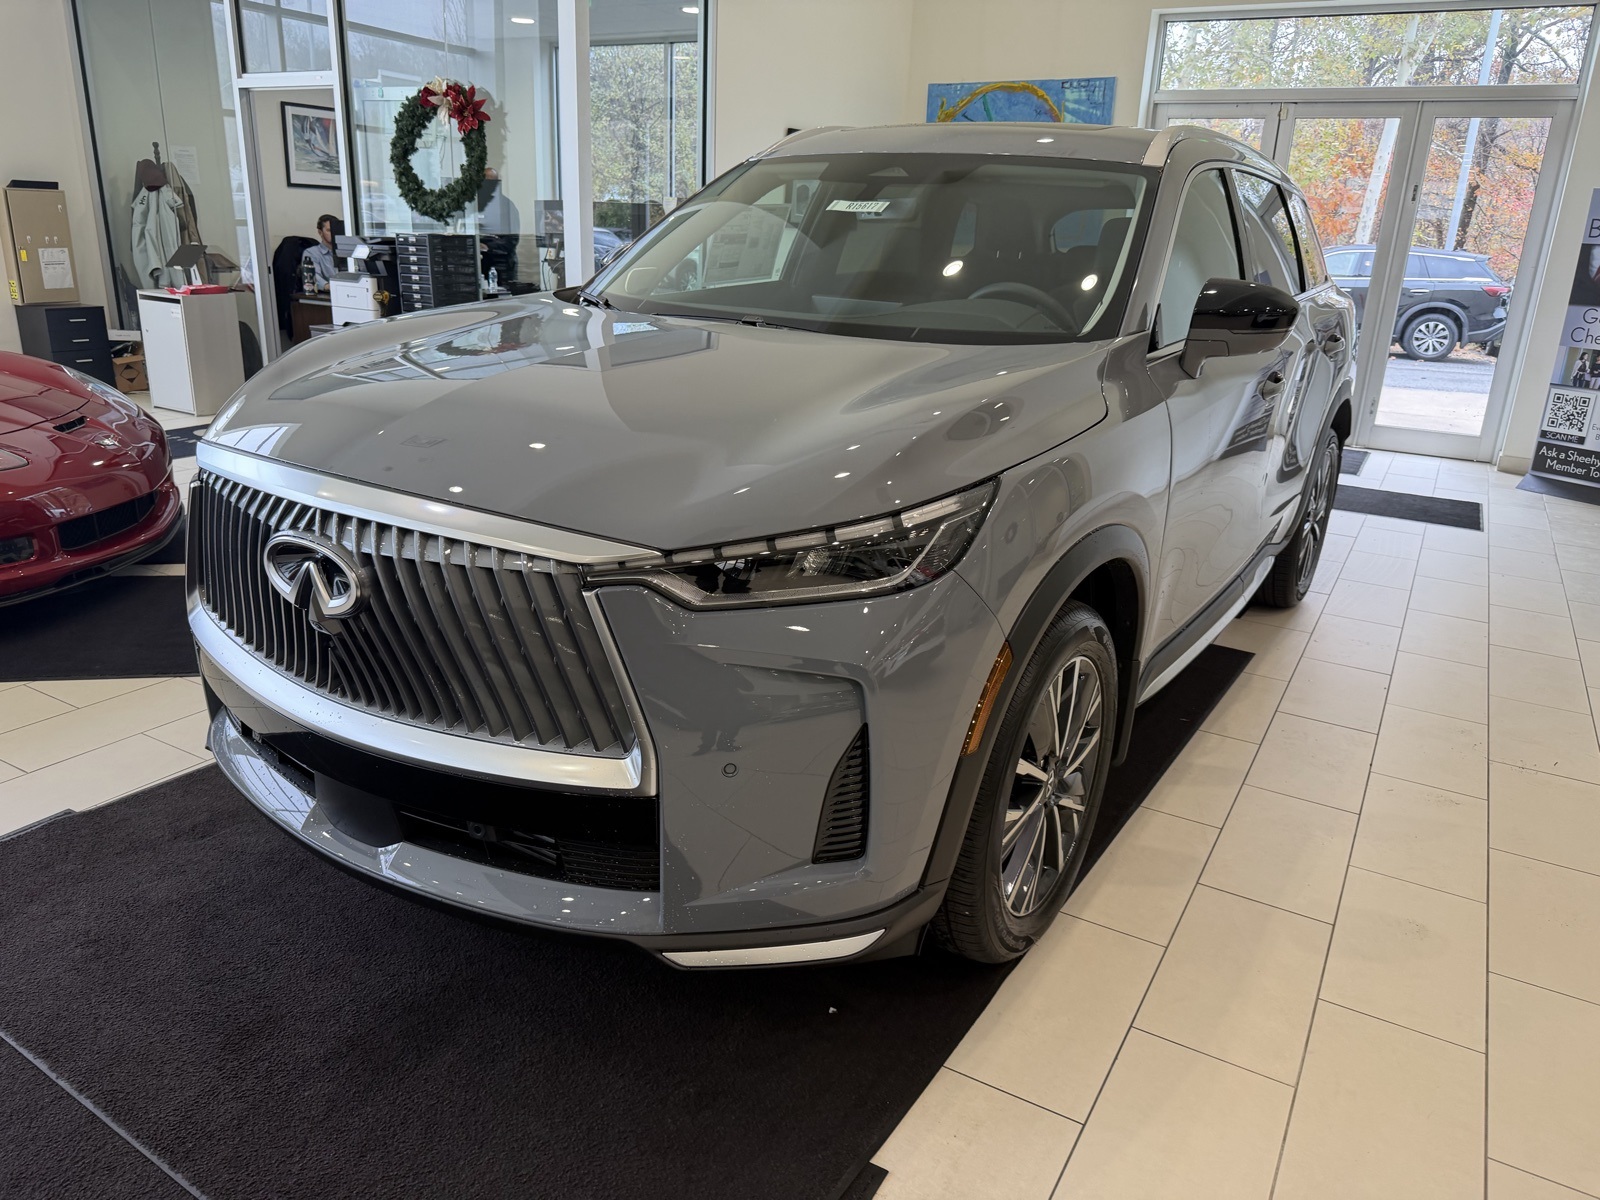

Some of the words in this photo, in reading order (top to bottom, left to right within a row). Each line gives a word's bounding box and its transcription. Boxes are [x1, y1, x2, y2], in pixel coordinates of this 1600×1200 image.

[1546, 432, 1567, 441] SCAN
[1568, 435, 1580, 443] ME
[1539, 446, 1558, 458] Ask
[1567, 451, 1600, 468] Sheehy
[1545, 458, 1587, 476] Member
